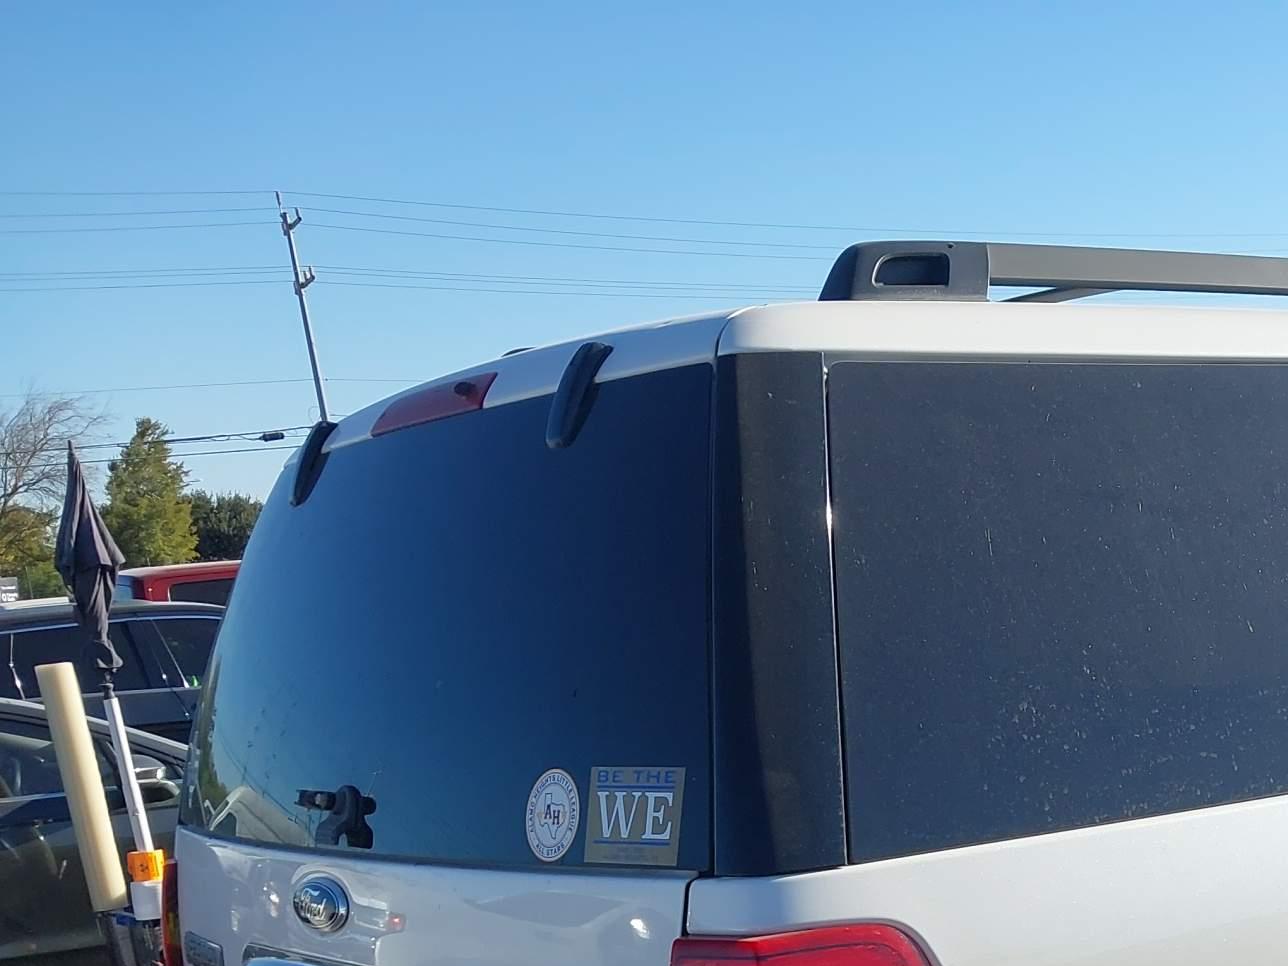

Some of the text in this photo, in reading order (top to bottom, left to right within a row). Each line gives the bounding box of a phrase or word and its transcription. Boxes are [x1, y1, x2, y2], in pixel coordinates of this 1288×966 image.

[597, 770, 677, 784] BE THE
[597, 791, 674, 840] WE
